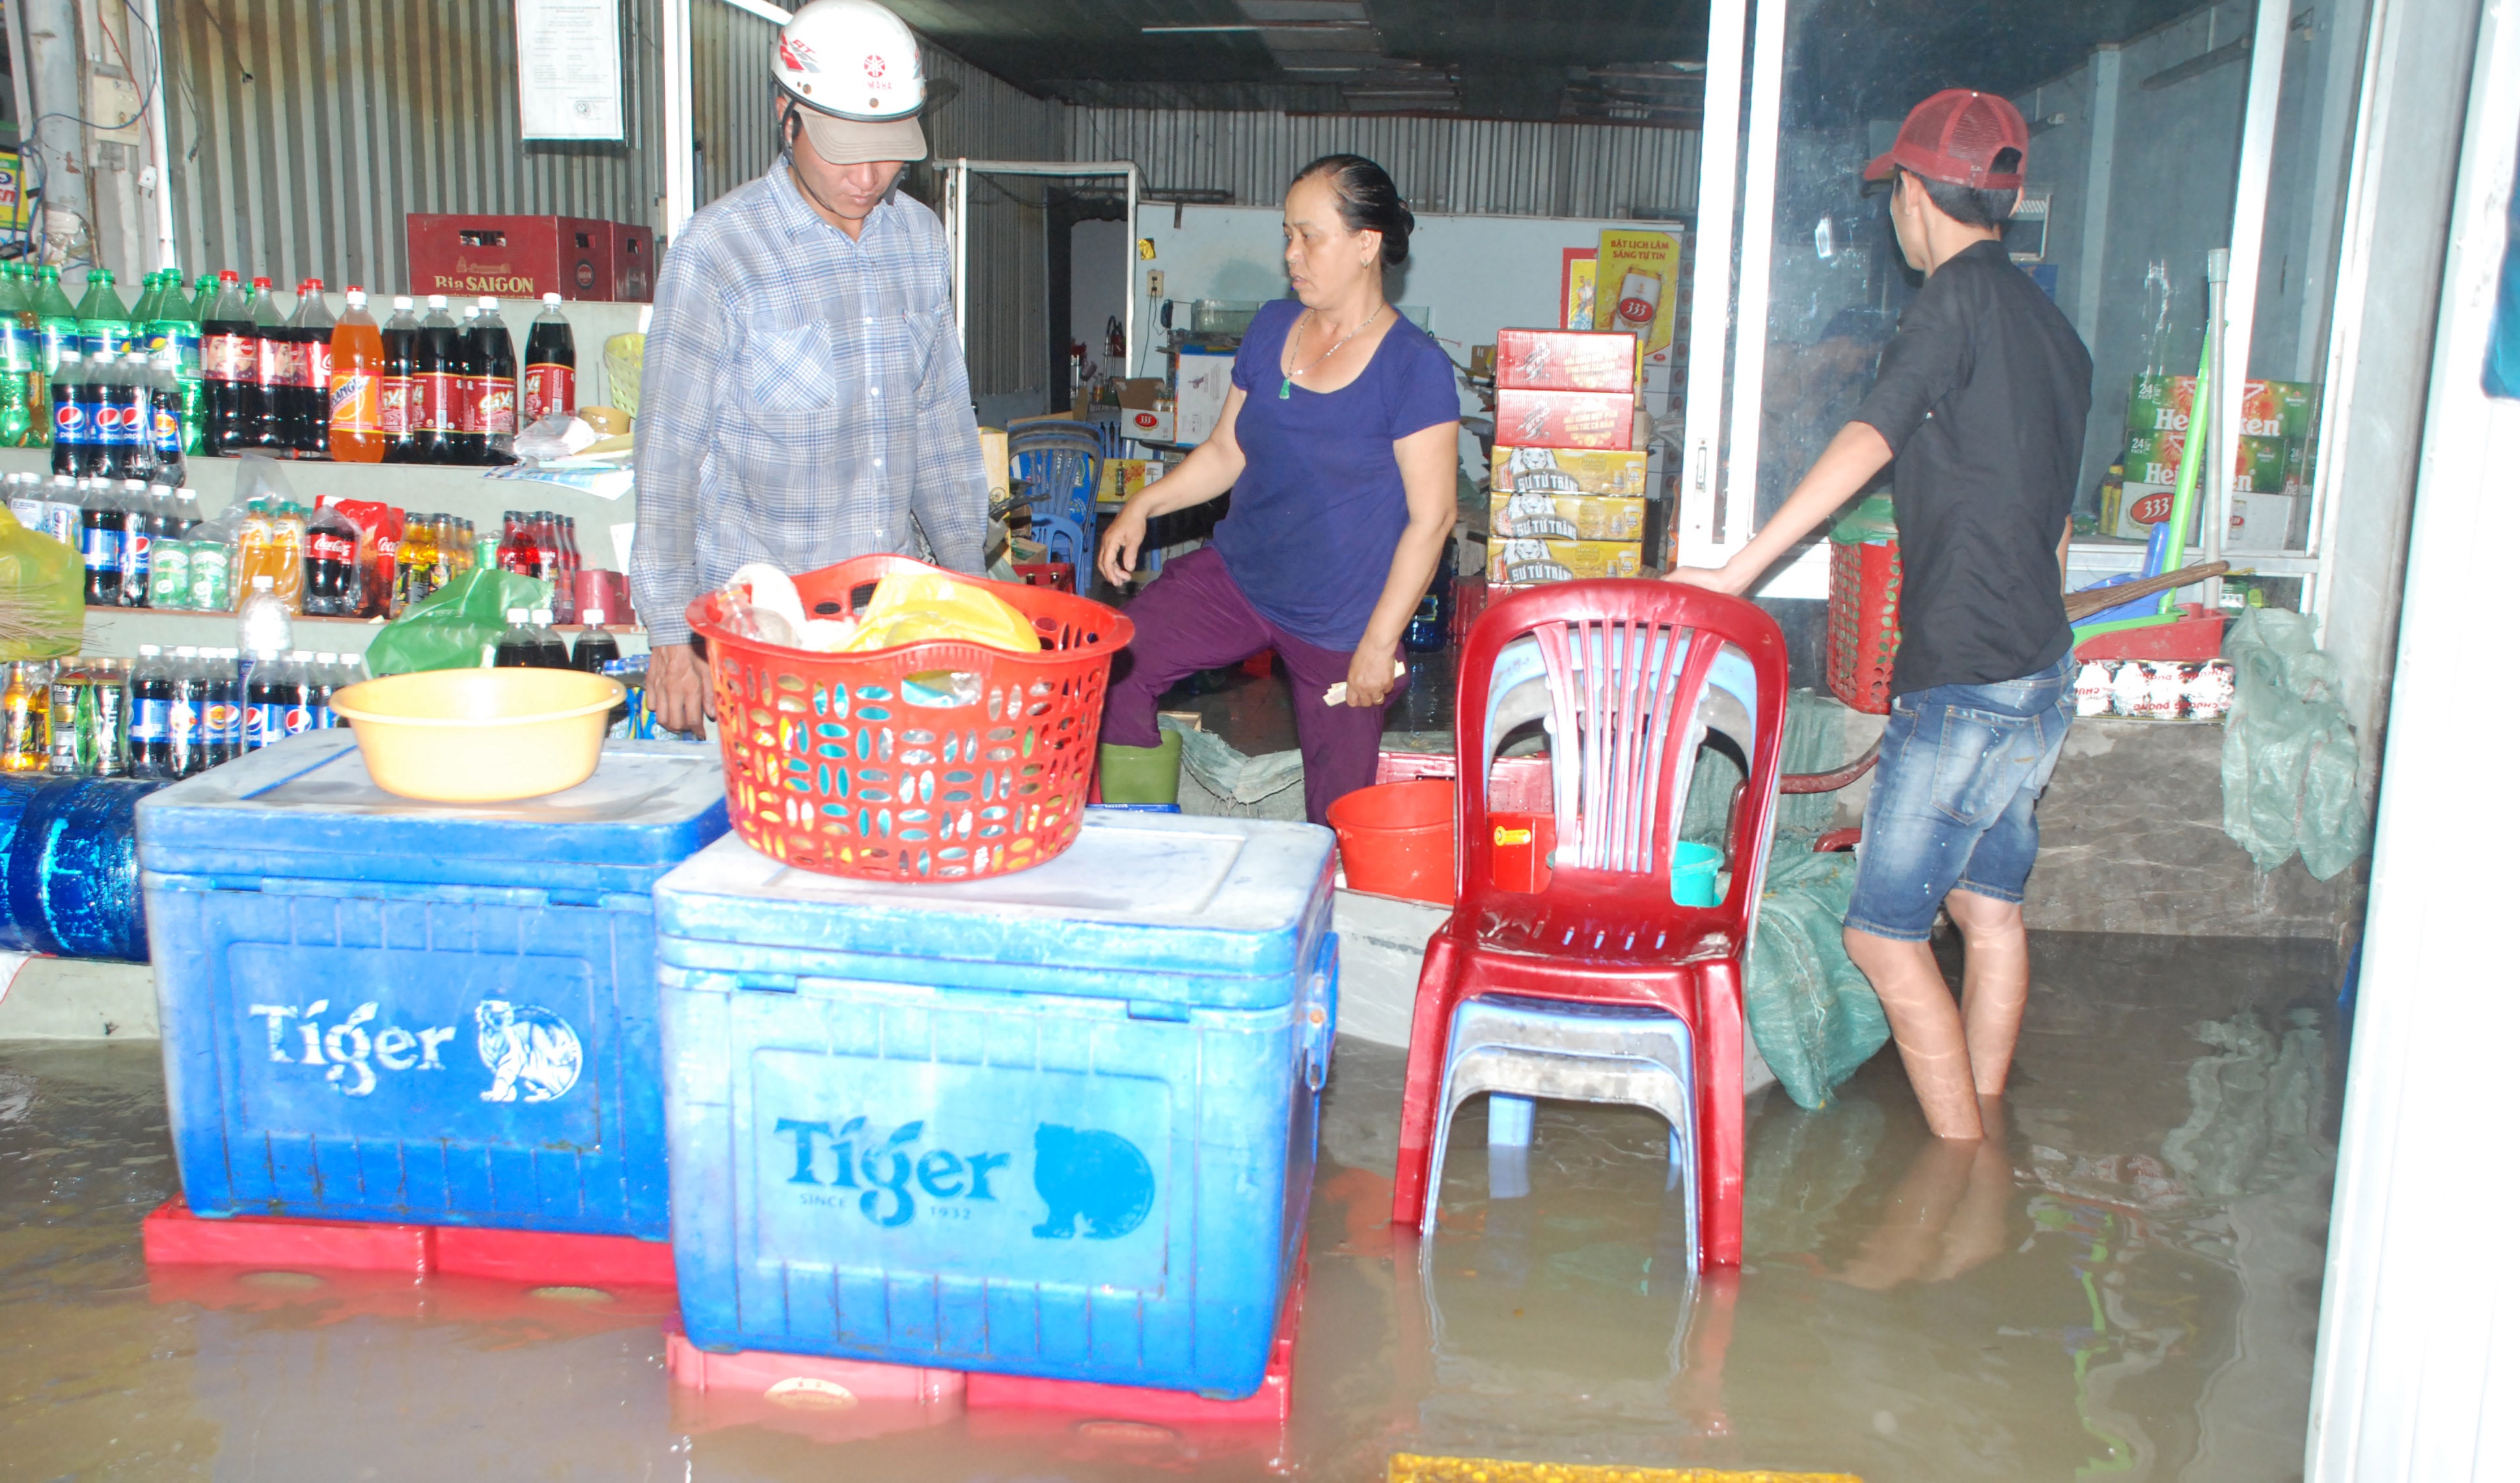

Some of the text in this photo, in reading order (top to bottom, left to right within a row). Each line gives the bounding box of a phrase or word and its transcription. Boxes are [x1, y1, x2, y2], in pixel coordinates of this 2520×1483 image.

[466, 276, 534, 292] SAIGON
[1625, 301, 1647, 316] 333
[2139, 383, 2154, 395] 24
[2131, 438, 2144, 449] 24
[2141, 497, 2169, 519] 333
[249, 999, 457, 1097] Tiger
[773, 1115, 1013, 1228] Tiger
[800, 1193, 972, 1220] SINCE 1932
